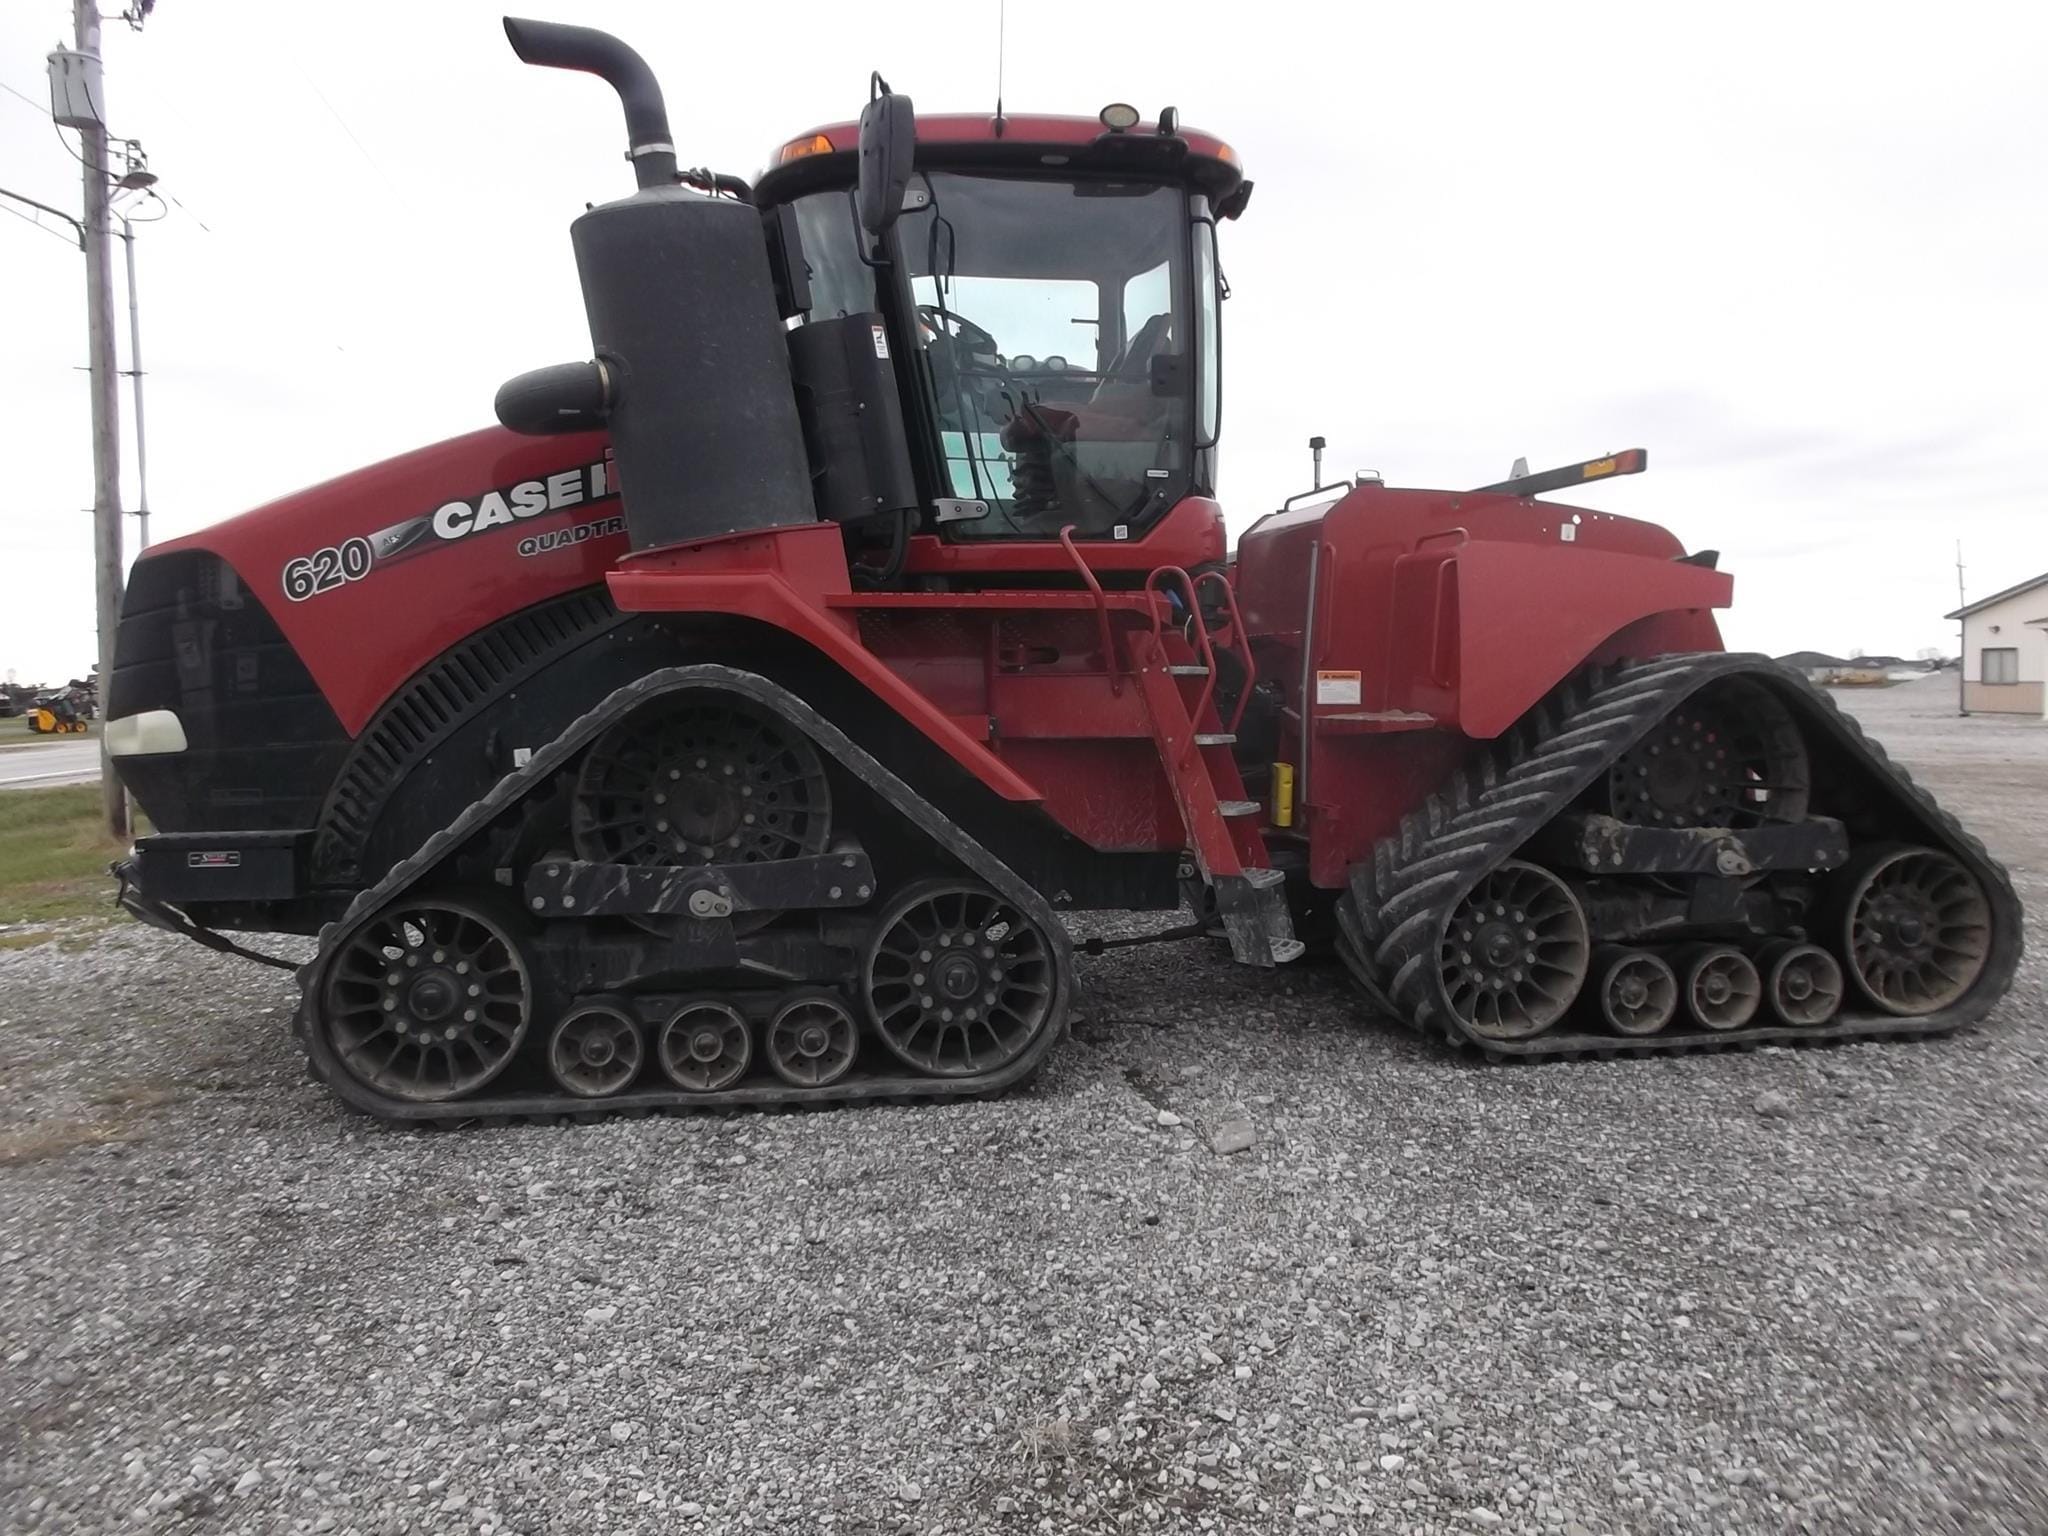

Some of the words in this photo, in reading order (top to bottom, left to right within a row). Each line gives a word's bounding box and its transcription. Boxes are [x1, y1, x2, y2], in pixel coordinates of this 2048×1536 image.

[431, 469, 584, 540] CASE
[517, 515, 629, 558] QUADTR
[283, 537, 372, 602] 620
